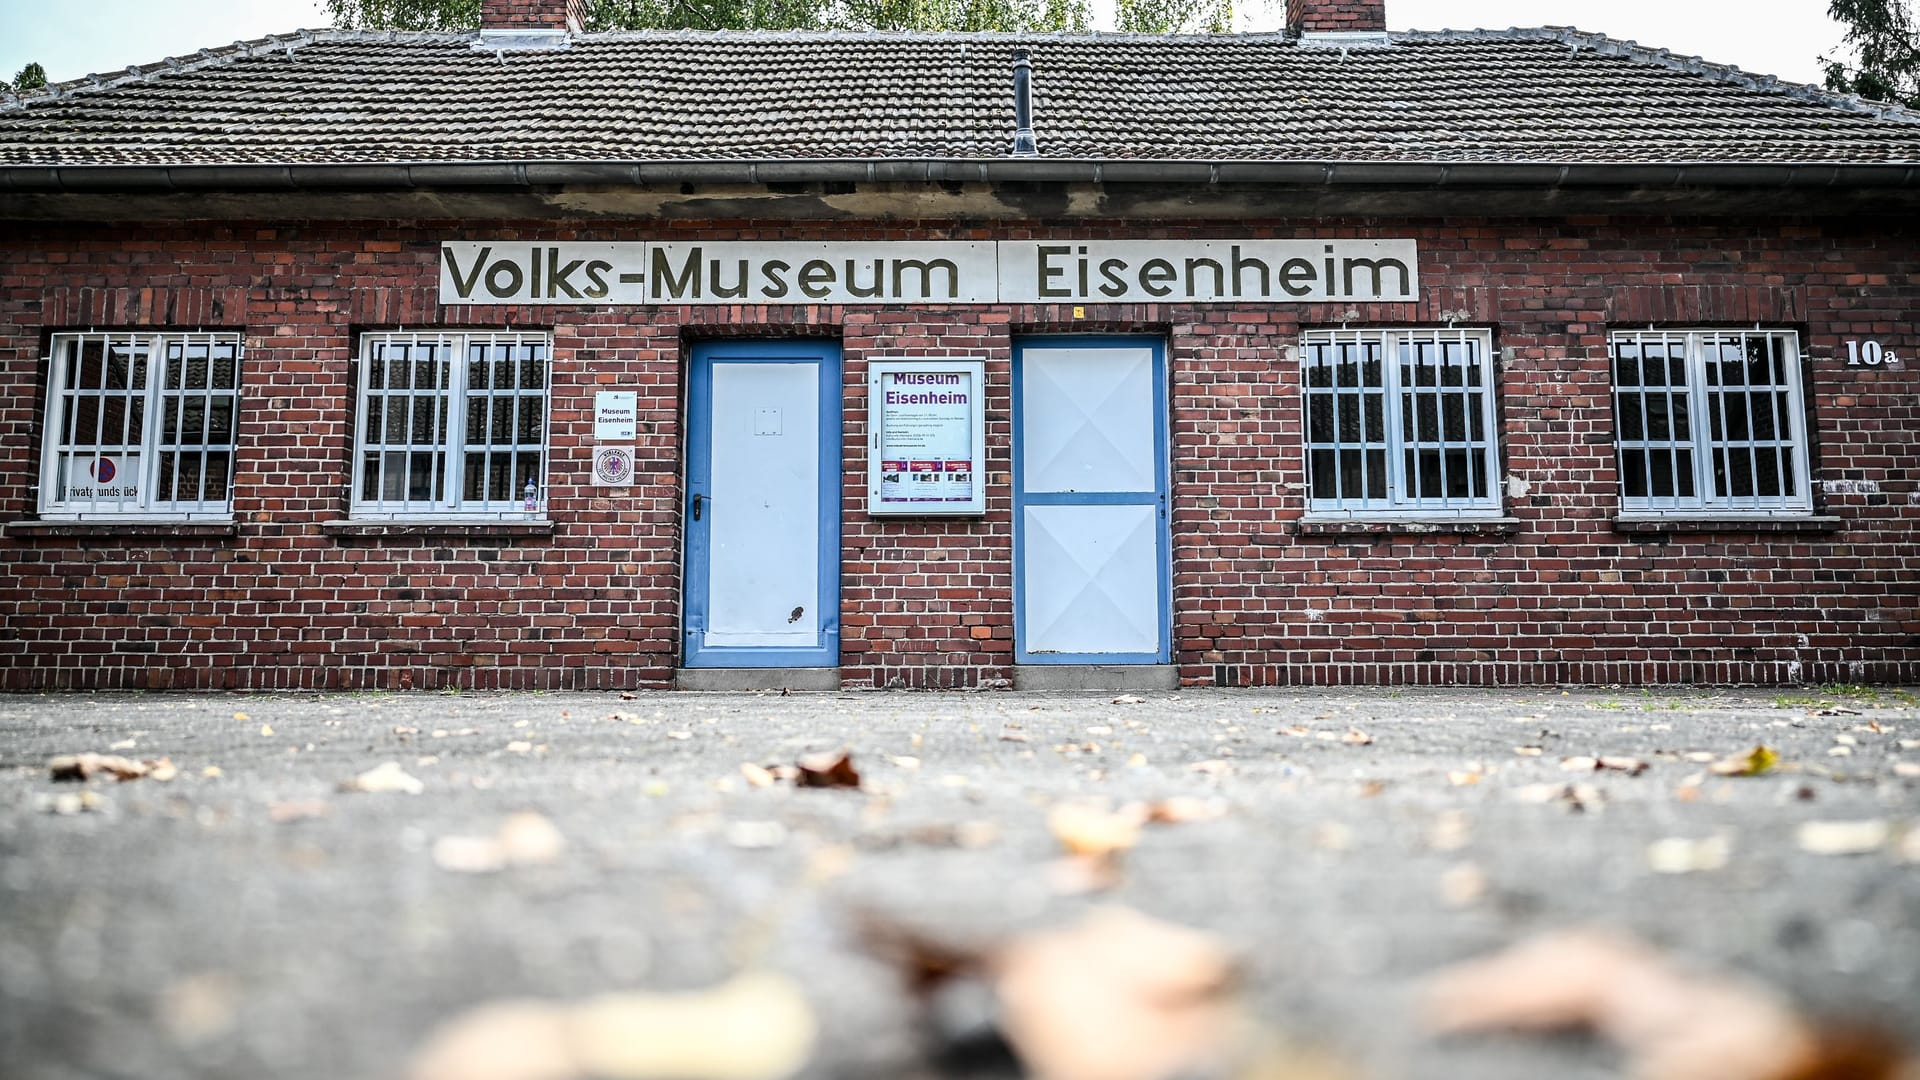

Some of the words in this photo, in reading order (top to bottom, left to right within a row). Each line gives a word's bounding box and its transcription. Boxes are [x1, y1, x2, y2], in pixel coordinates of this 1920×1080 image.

[442, 246, 959, 299] Volks-Museum
[1037, 244, 1411, 298] Eisenheim
[1845, 340, 1899, 366] 10a
[893, 372, 960, 385] Museum
[886, 391, 968, 405] Eisenheim
